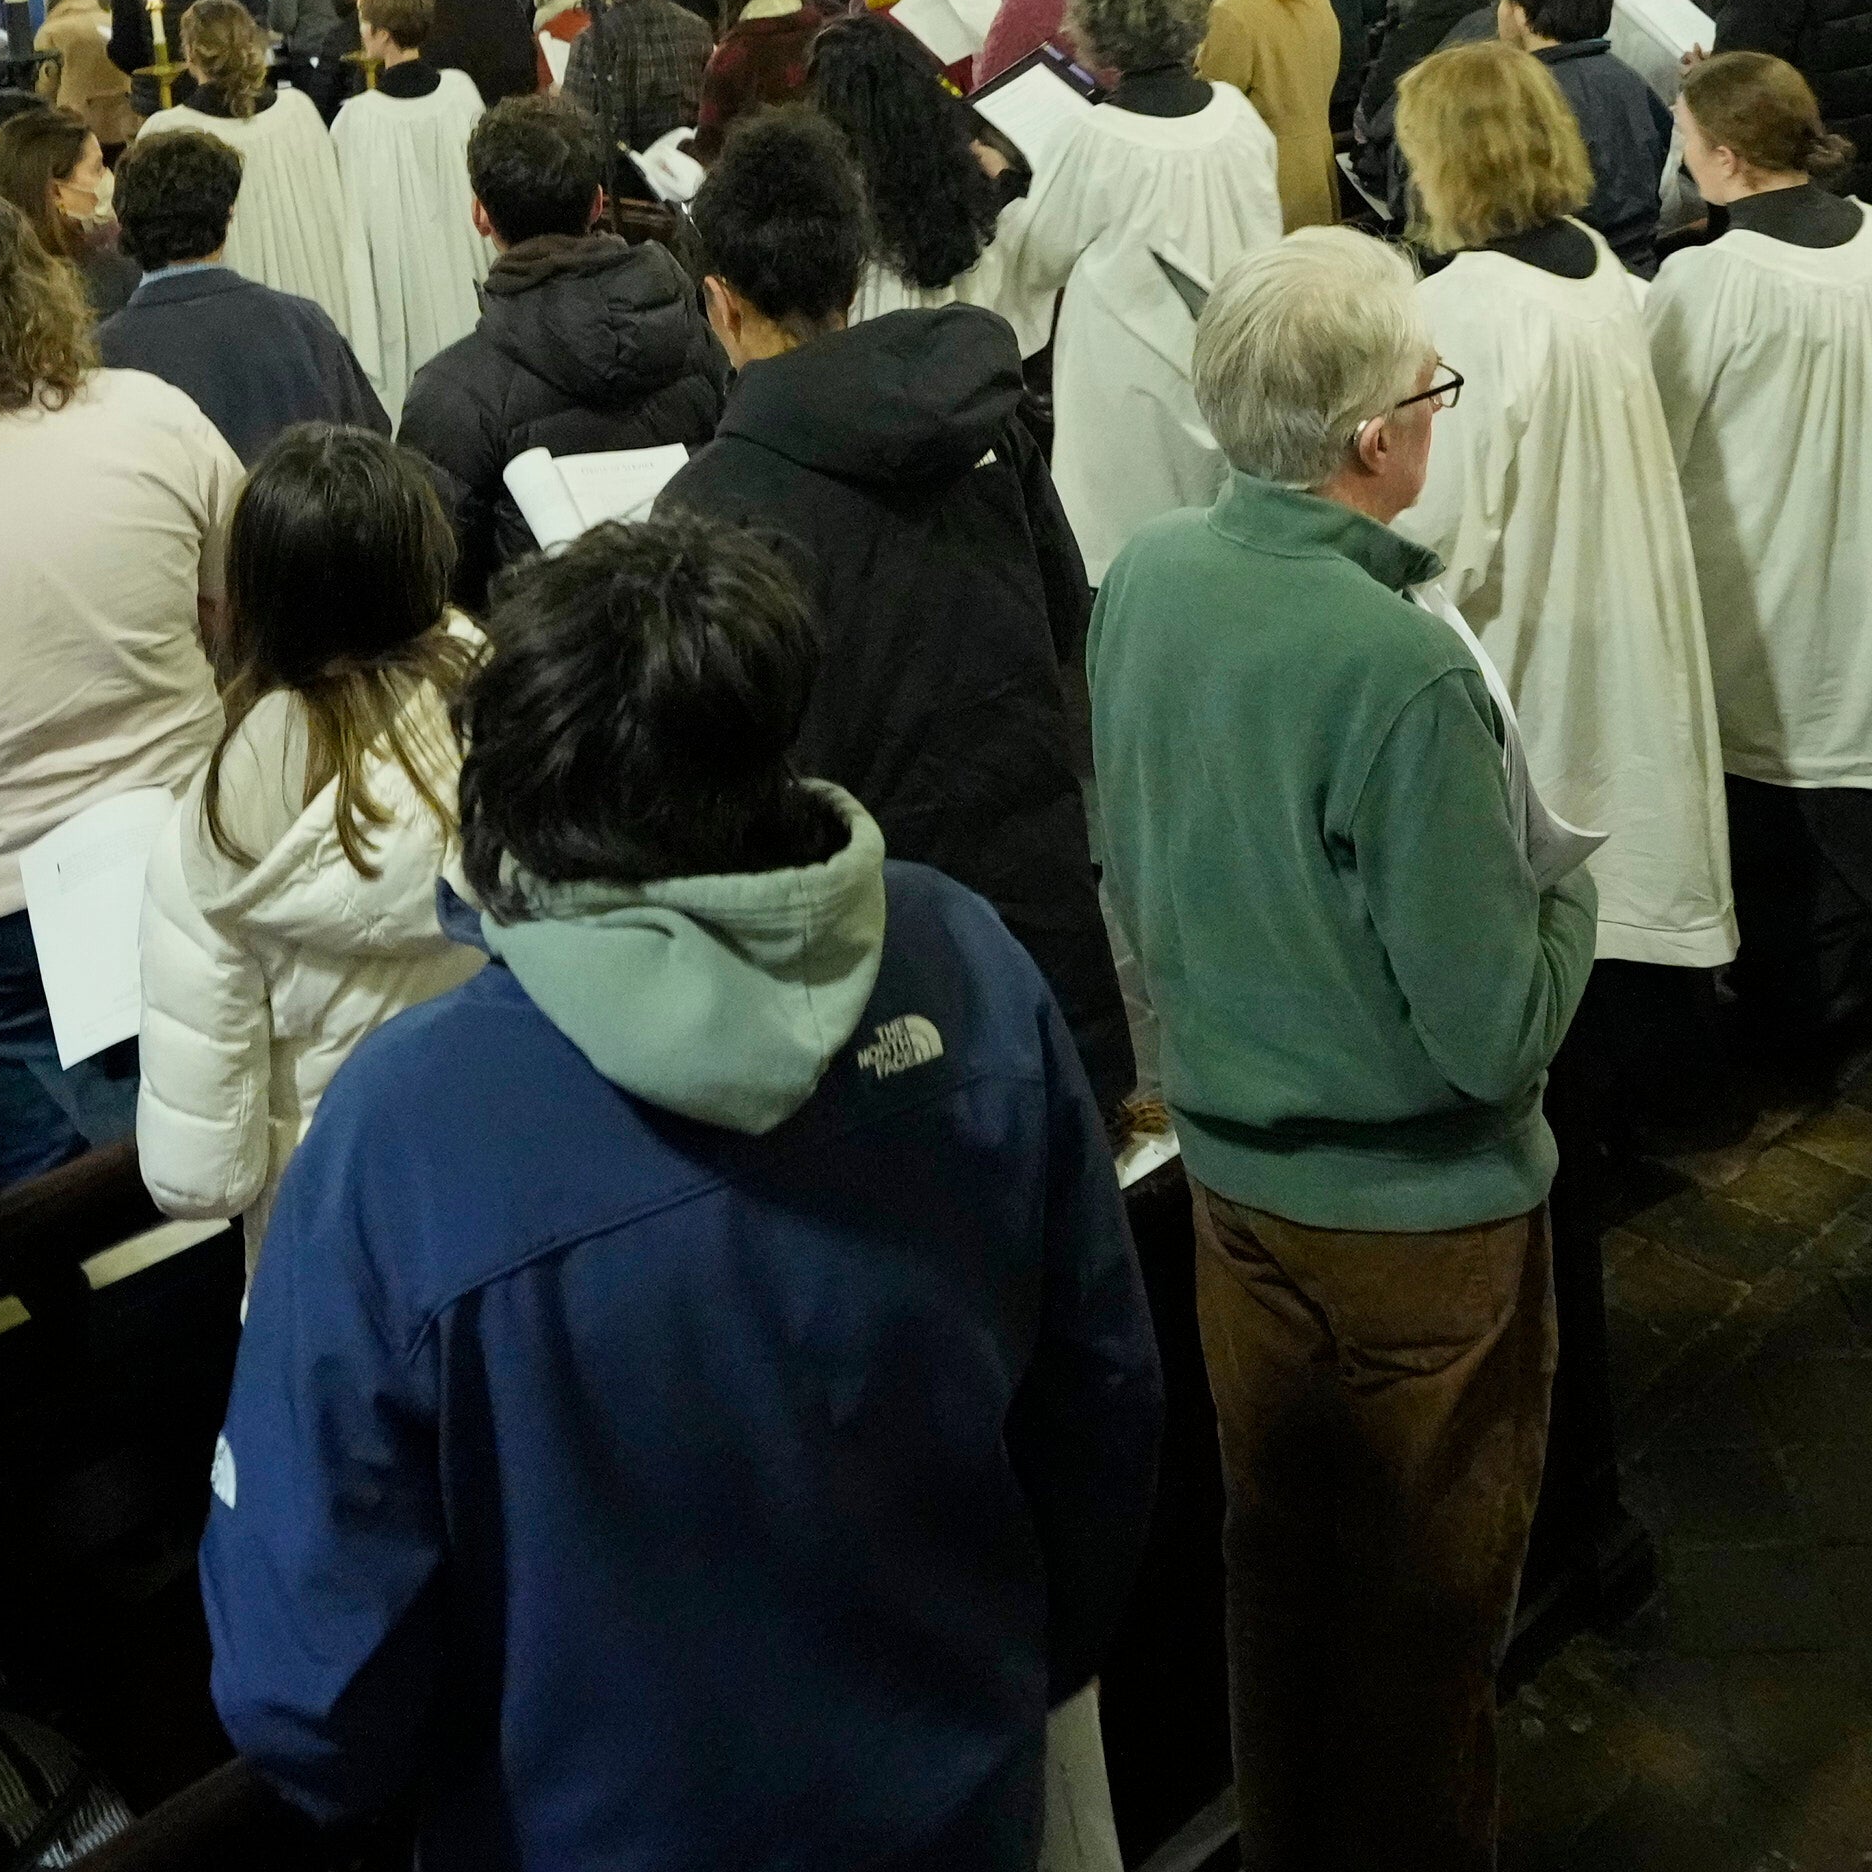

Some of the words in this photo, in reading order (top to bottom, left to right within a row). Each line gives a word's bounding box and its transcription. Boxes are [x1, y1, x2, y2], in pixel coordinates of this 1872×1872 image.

[875, 1017, 909, 1044] THE
[858, 1031, 913, 1069] NORTH
[876, 1048, 917, 1079] FACE
